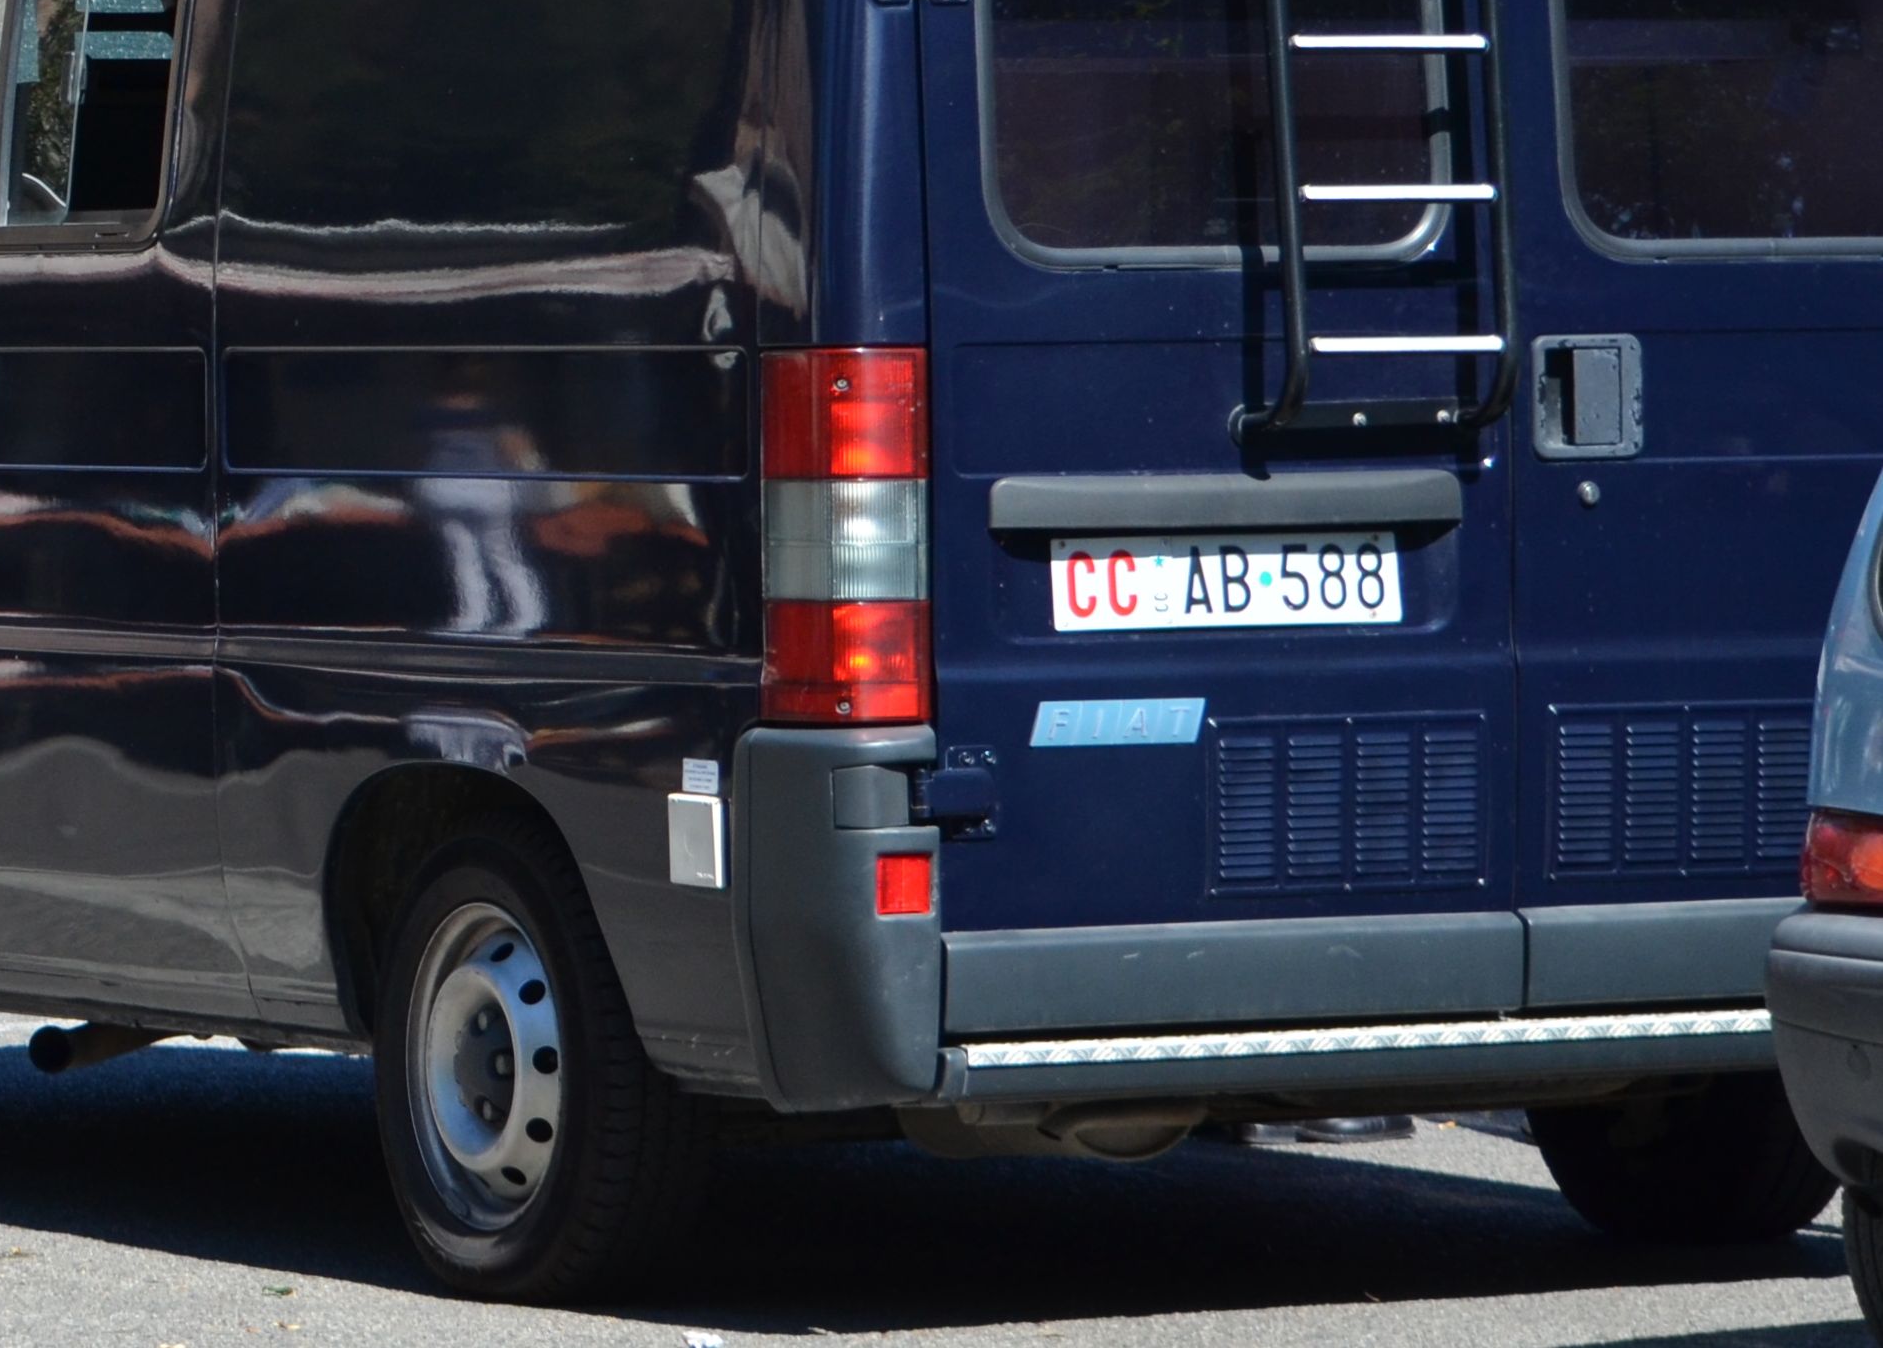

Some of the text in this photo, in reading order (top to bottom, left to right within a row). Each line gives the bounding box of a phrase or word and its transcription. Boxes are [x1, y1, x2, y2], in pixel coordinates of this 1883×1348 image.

[1066, 543, 1385, 618] CC AB 588
[1047, 706, 1192, 740] FIAT
